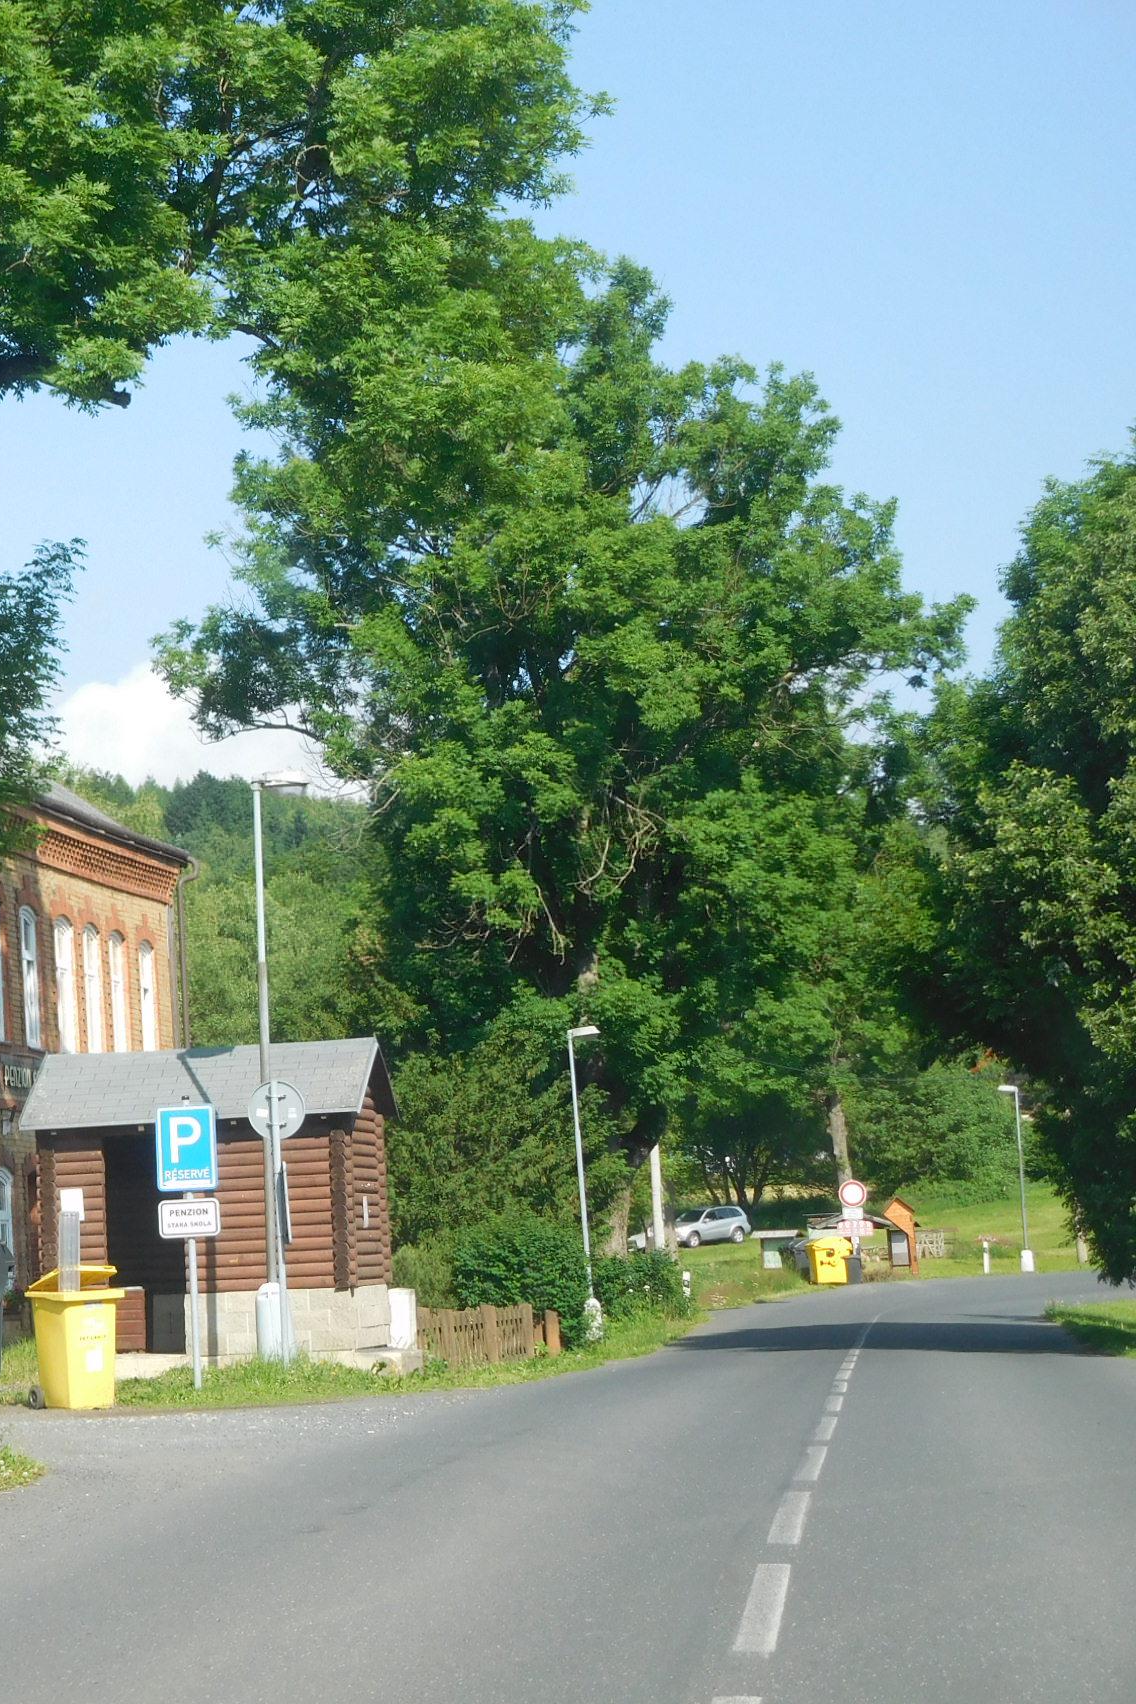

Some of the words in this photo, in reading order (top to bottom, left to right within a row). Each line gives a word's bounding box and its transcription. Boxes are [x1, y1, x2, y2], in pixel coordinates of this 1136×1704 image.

[169, 1116, 201, 1164] P
[164, 1167, 211, 1180] RÉSERVÉ
[169, 1208, 209, 1217] PENZION
